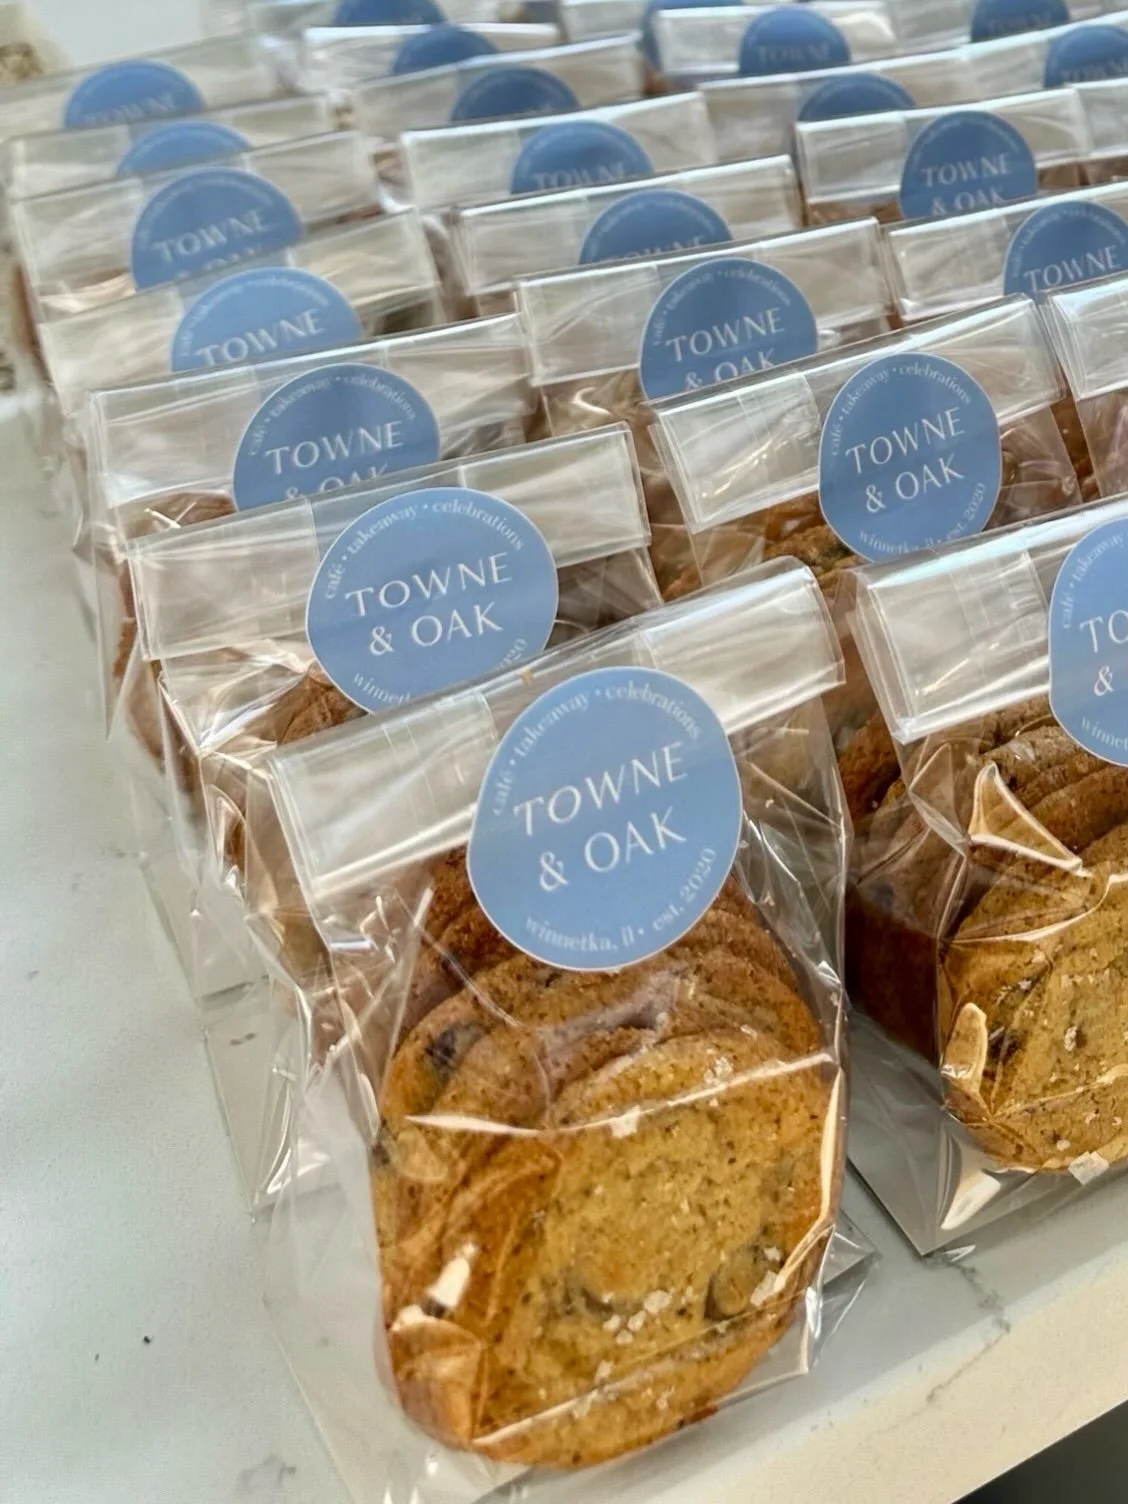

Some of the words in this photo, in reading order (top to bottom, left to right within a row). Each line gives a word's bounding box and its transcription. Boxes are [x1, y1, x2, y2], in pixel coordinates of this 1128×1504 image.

[921, 152, 1014, 188] TOWNE
[1023, 245, 1122, 292] TOWNE
[193, 308, 326, 367] TOWNE
[665, 306, 785, 363] TOWNE
[685, 371, 703, 391] &
[715, 347, 776, 382] OAK
[264, 420, 405, 476] TOWNE
[845, 406, 966, 475] TOWNE
[865, 484, 887, 513] &
[895, 452, 965, 500] OAK
[432, 498, 526, 552] celebrations
[344, 551, 514, 618] TOWNE
[369, 625, 396, 657] &
[411, 600, 504, 648] OAK
[1093, 665, 1115, 697] &
[604, 680, 702, 742] celebrations
[512, 741, 689, 836] TOWNE
[538, 850, 569, 893] &
[584, 805, 687, 873] OAK
[679, 847, 717, 903] 2020
